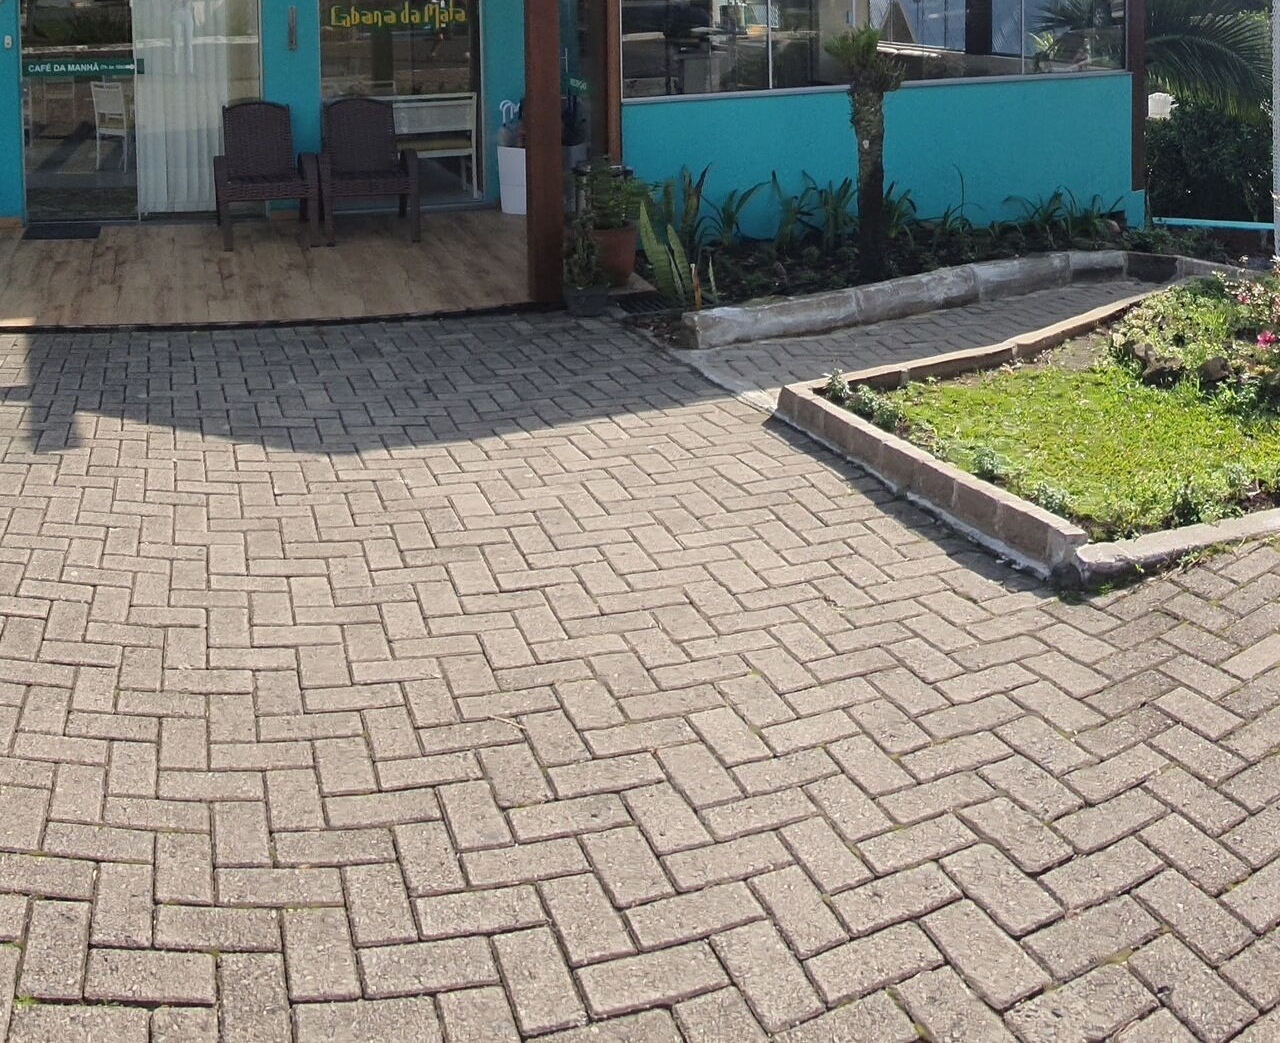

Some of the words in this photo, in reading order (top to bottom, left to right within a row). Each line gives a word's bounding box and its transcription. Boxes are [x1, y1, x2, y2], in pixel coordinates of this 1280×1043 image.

[331, 5, 397, 27] Cabana
[400, 1, 421, 24] da
[28, 63, 52, 73] CAFÉ
[53, 64, 66, 72] DA
[67, 62, 100, 72] MANHÃ
